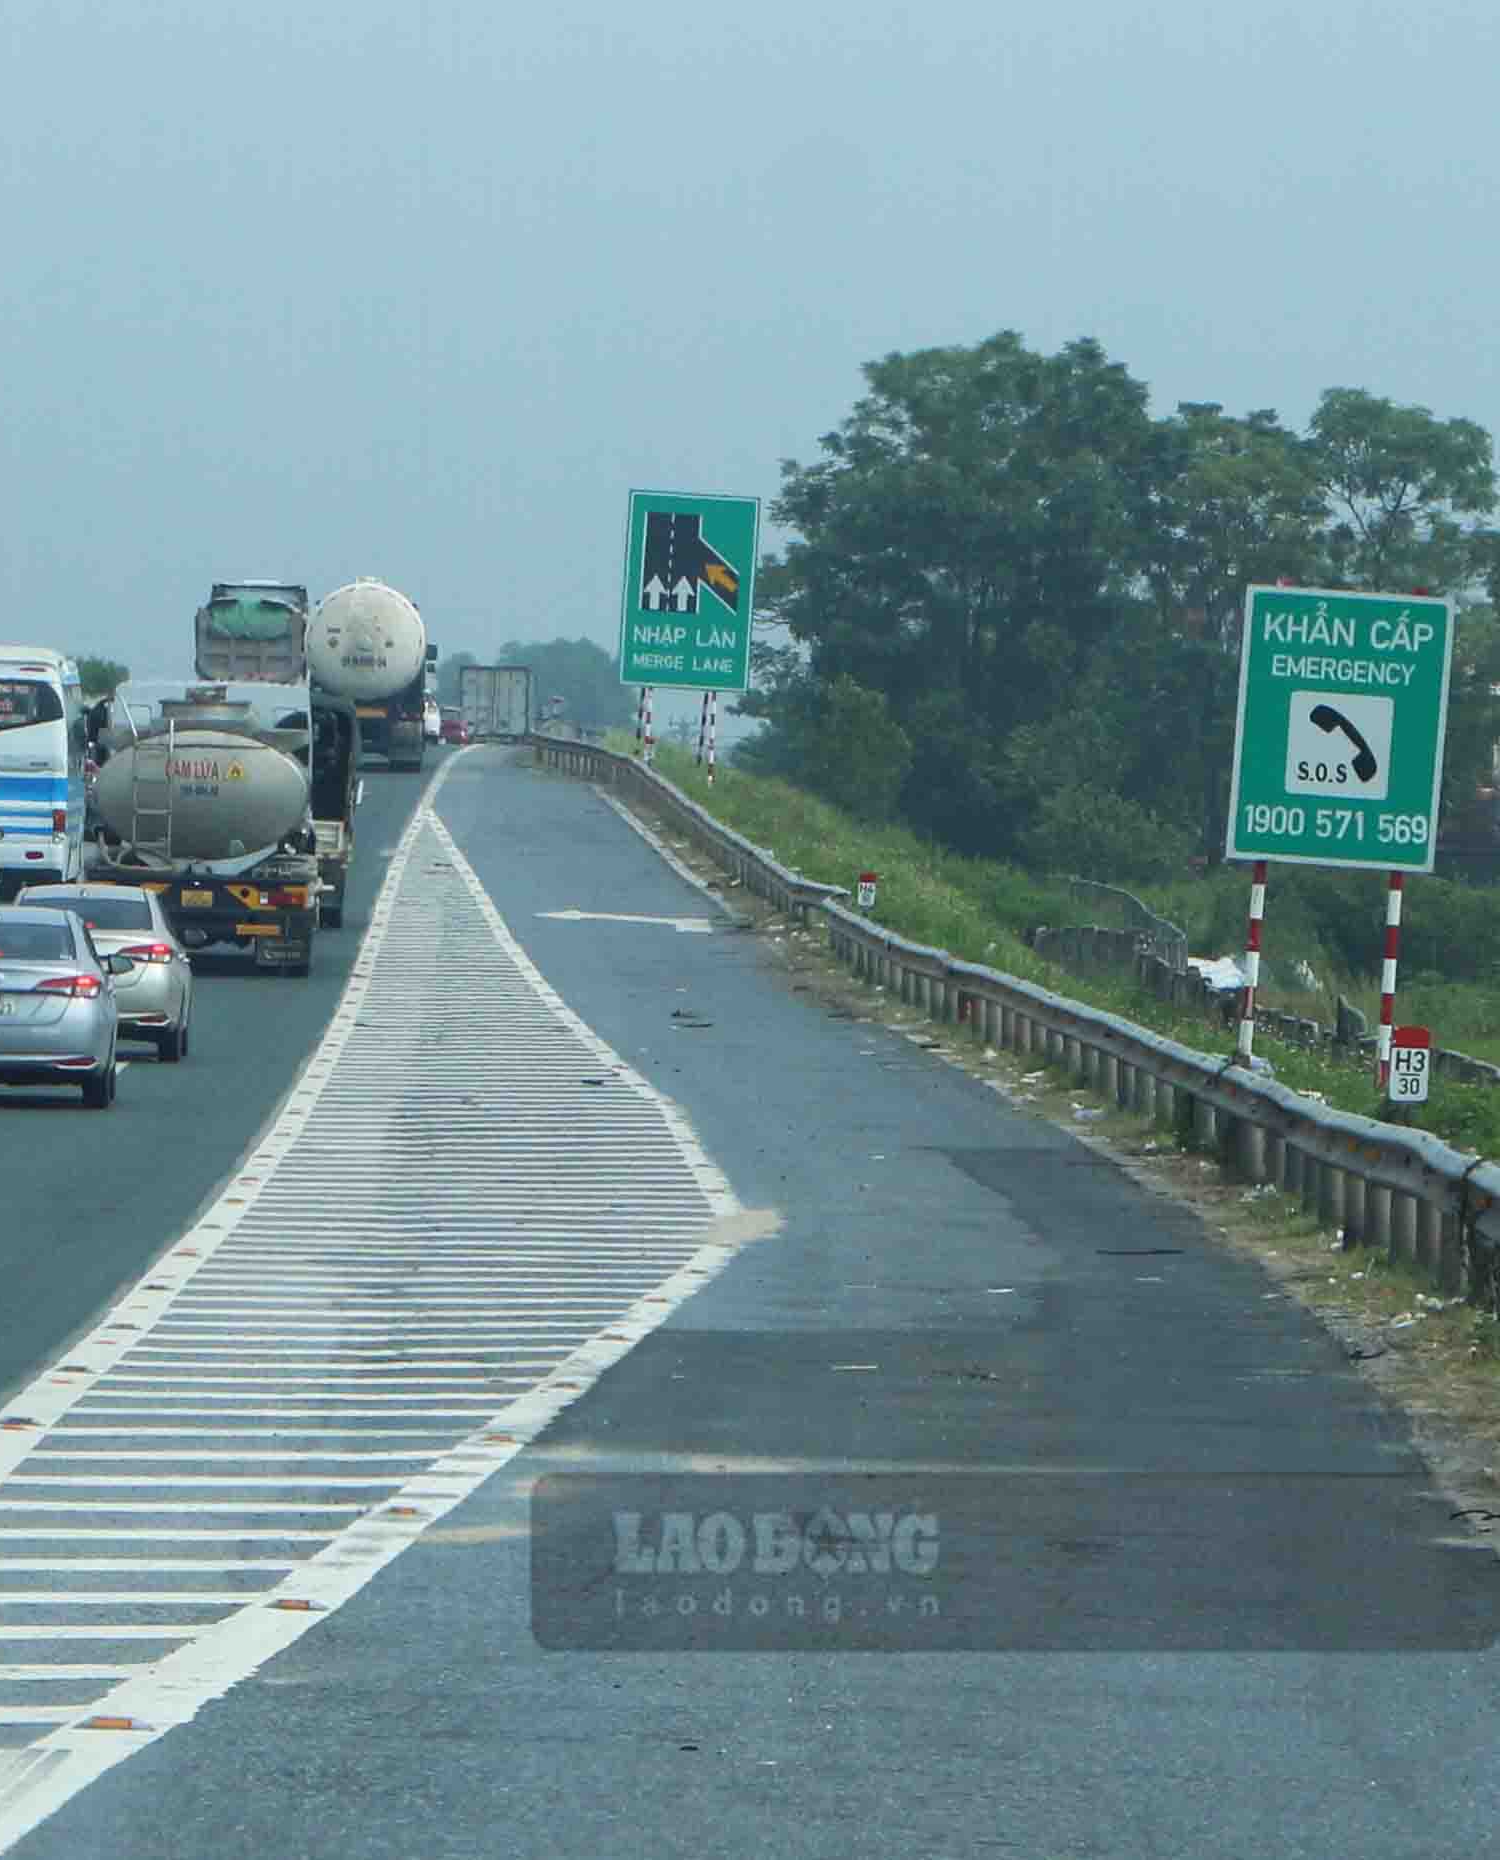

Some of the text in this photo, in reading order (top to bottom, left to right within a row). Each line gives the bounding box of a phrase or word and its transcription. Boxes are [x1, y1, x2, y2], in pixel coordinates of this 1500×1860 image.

[1263, 602, 1434, 652] KHẨN CẤP
[632, 653, 733, 673] MERGE LANE
[1271, 654, 1416, 686] EMERGENCY
[1297, 761, 1348, 783] S.O.S
[1245, 804, 1428, 844] 1900 571 569
[1395, 1049, 1426, 1073] H3
[1397, 1077, 1421, 1095] 30
